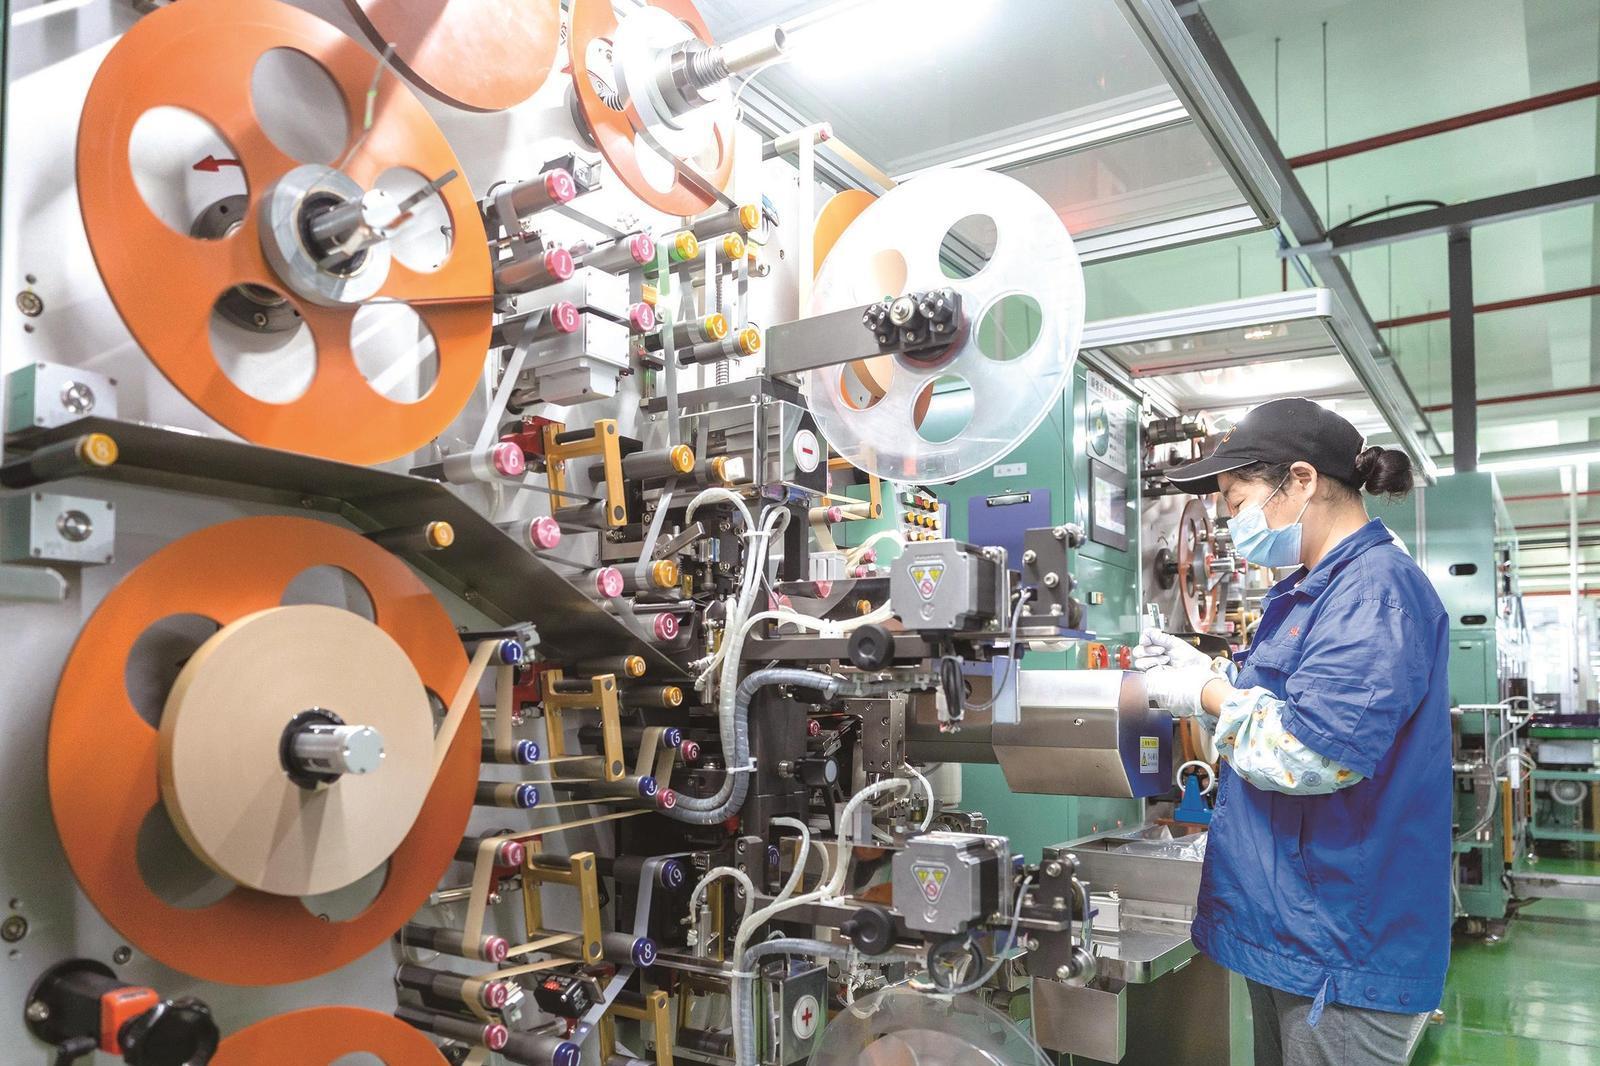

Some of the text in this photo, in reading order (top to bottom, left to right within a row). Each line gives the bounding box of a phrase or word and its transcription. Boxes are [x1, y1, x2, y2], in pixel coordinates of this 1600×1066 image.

[560, 178, 569, 196] 2
[750, 210, 755, 223] 1
[642, 240, 649, 255] 3
[735, 240, 741, 253] 3
[560, 255, 566, 272] 1
[566, 308, 574, 325] 5
[642, 309, 649, 324] 4
[717, 318, 723, 332] 4
[750, 334, 757, 347] 2
[509, 449, 518, 468] 6
[682, 451, 688, 465] 6
[547, 525, 555, 541] 7
[667, 567, 673, 581] 7
[609, 576, 616, 591] 8
[666, 618, 674, 633] 9
[512, 648, 518, 660] 1
[634, 662, 644, 674] 10
[675, 732, 681, 744] 5
[529, 745, 537, 759] 2
[691, 747, 697, 758] 6
[648, 780, 654, 791] 4
[529, 790, 537, 804] 3
[667, 793, 673, 804] 5
[514, 849, 521, 862] 4
[769, 854, 778, 865] 10
[673, 868, 682, 882] 9
[497, 944, 505, 958] 3
[644, 943, 651, 959] 8
[497, 990, 504, 1003] 2
[496, 1031, 502, 1045] 1
[567, 1049, 575, 1066] 7
